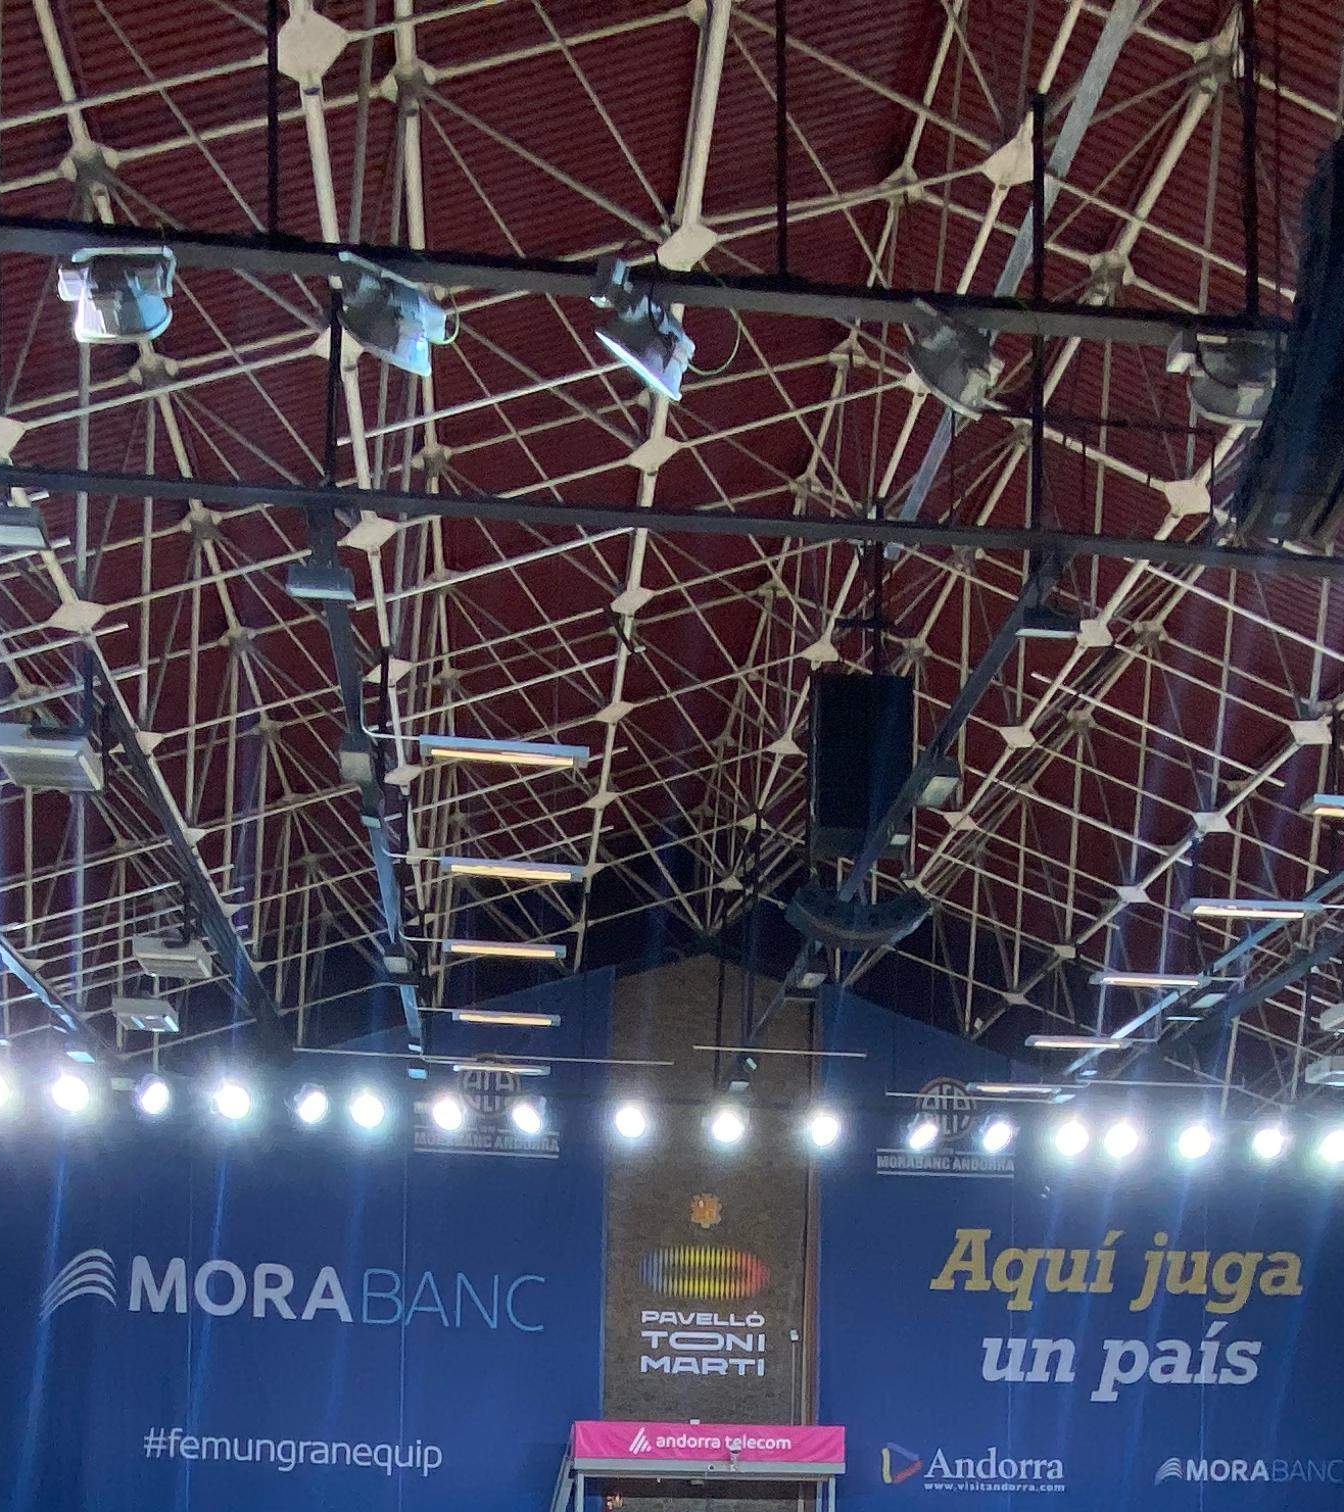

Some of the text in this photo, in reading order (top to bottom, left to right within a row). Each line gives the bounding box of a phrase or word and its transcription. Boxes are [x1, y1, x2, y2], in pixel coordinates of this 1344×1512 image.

[929, 1229, 1303, 1314] Aquí juga
[641, 1310, 766, 1327] PAVELLÓ
[640, 1330, 766, 1352] TONI
[981, 1322, 1261, 1402] un país
[143, 1427, 443, 1476] #femungranequip
[656, 1434, 792, 1450] andorra telecom
[924, 1447, 1065, 1479] Andorra
[924, 1481, 1065, 1494] www.visitandorra.com
